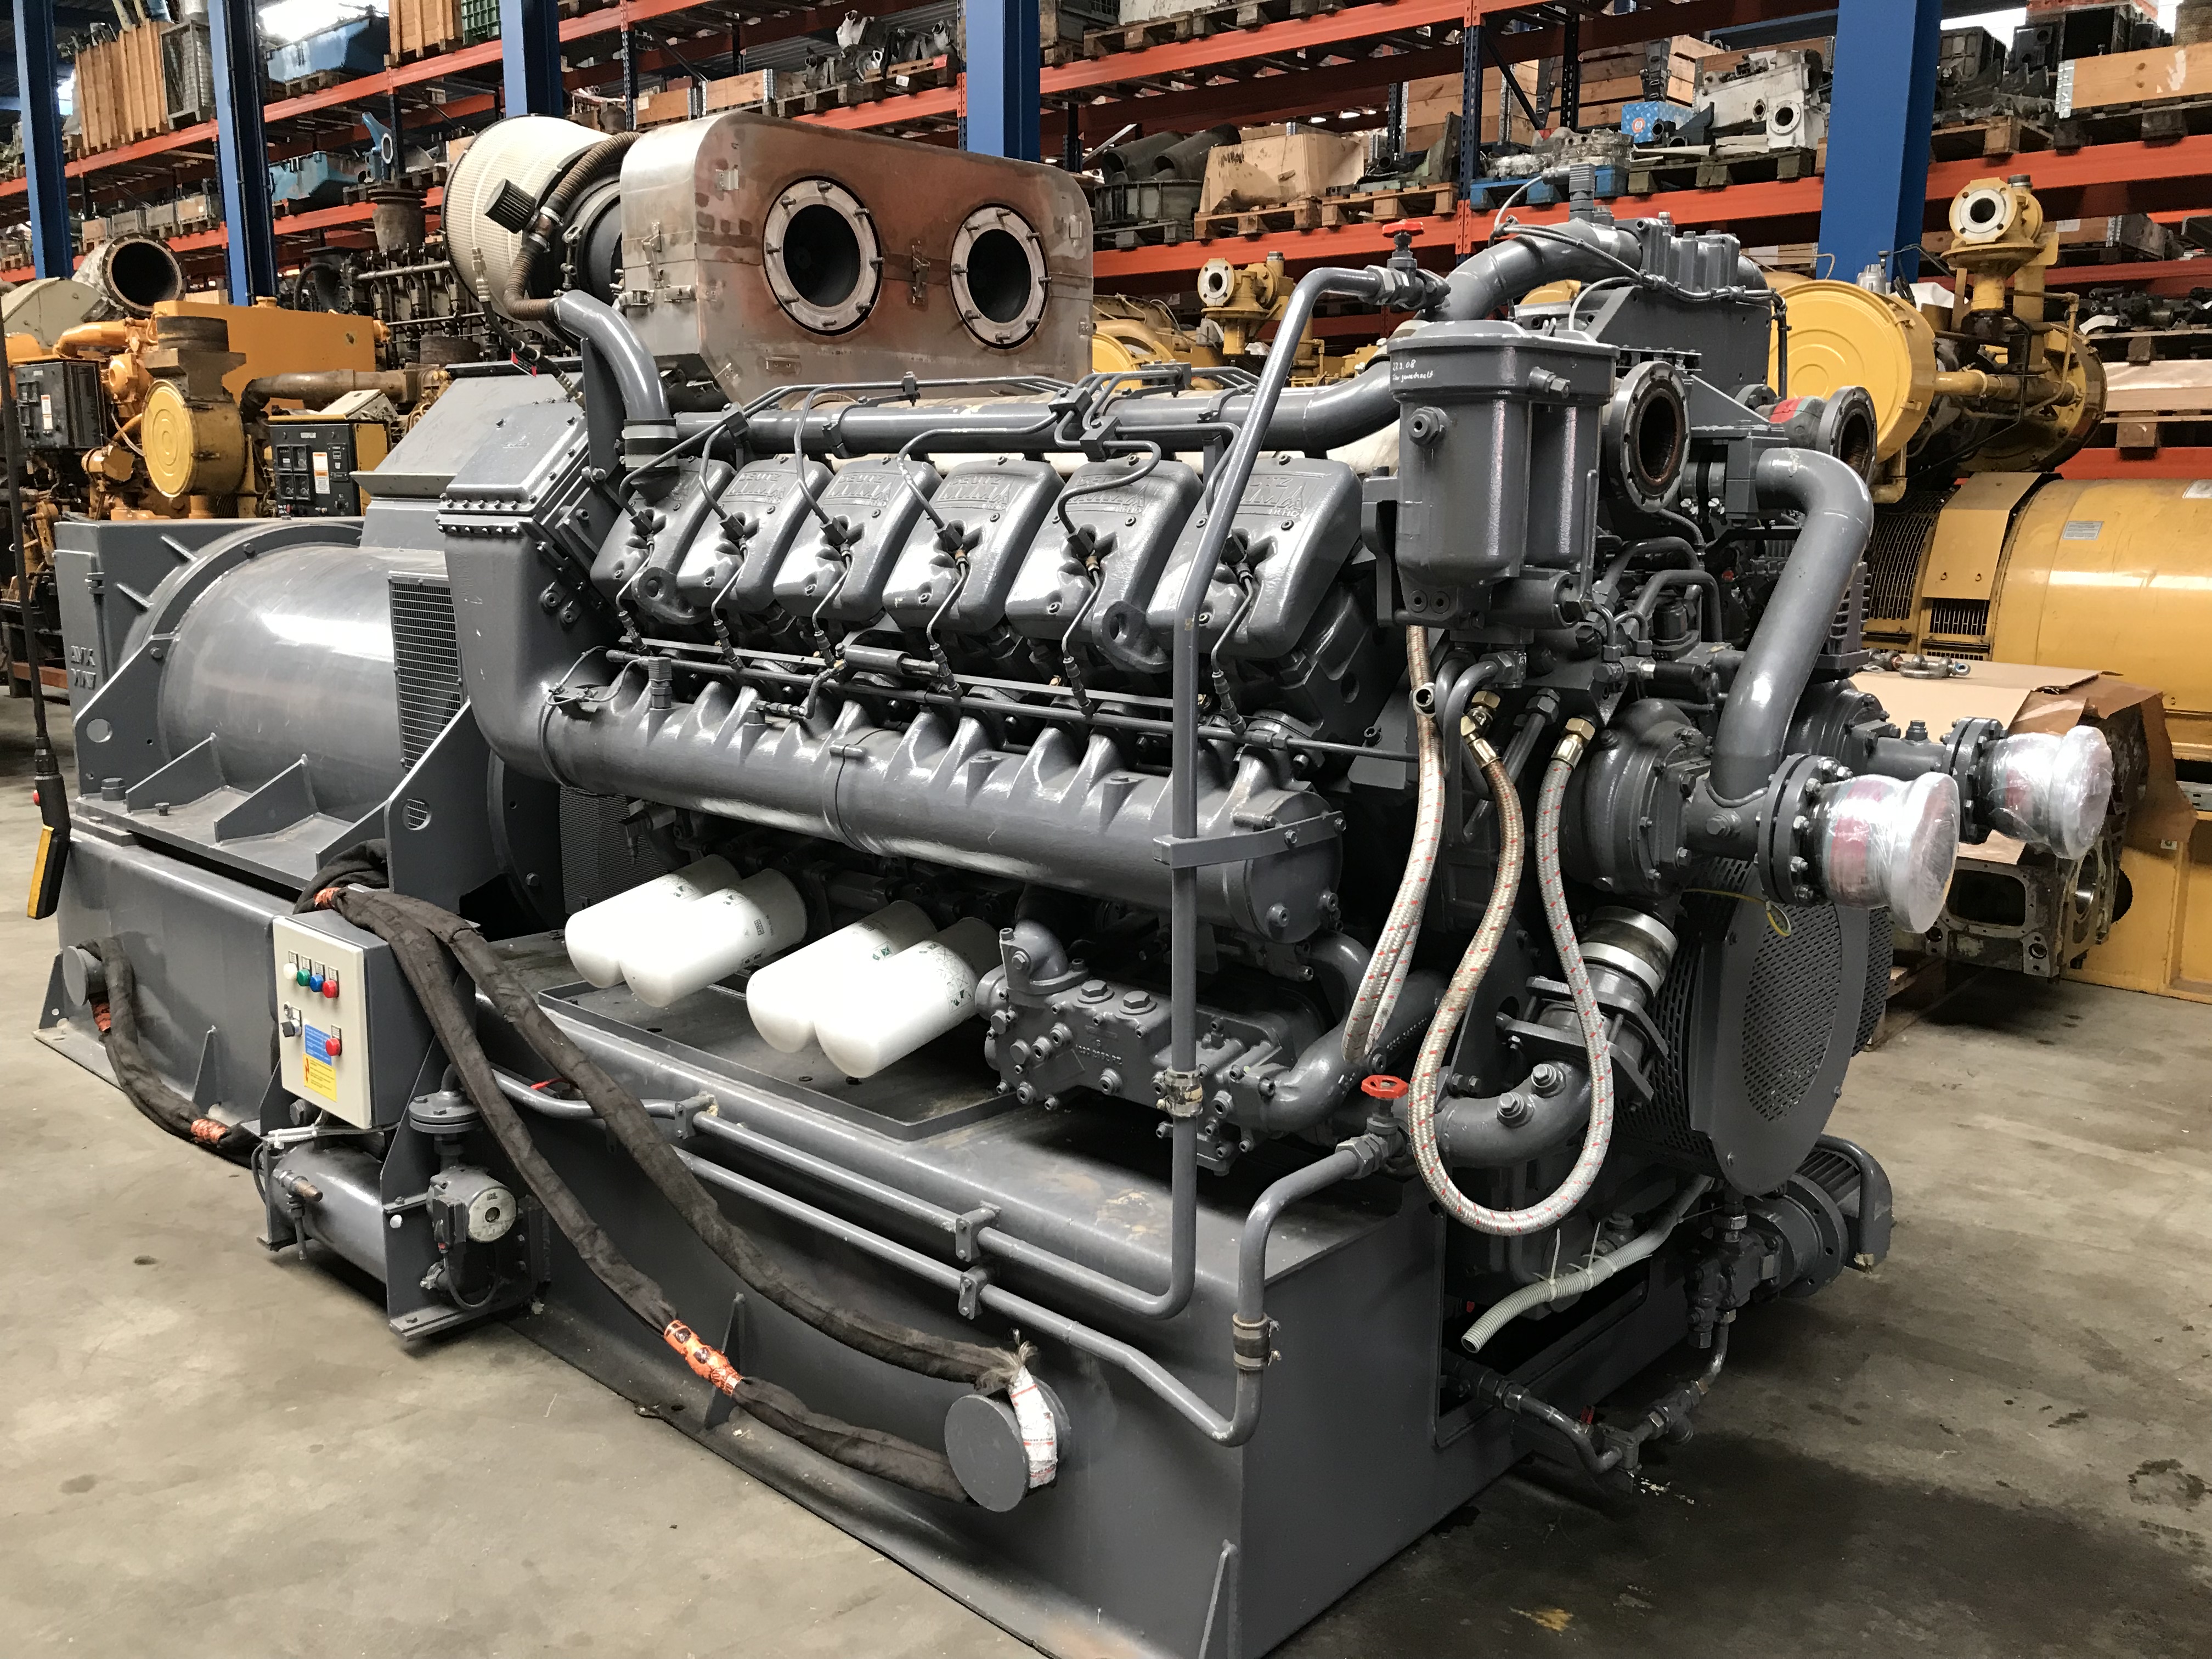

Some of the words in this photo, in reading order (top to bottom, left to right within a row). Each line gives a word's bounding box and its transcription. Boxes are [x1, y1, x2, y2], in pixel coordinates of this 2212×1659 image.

[738, 473, 782, 482] DEUTZ
[837, 474, 887, 483] DEUTZ
[949, 476, 1005, 486] DEUTZ
